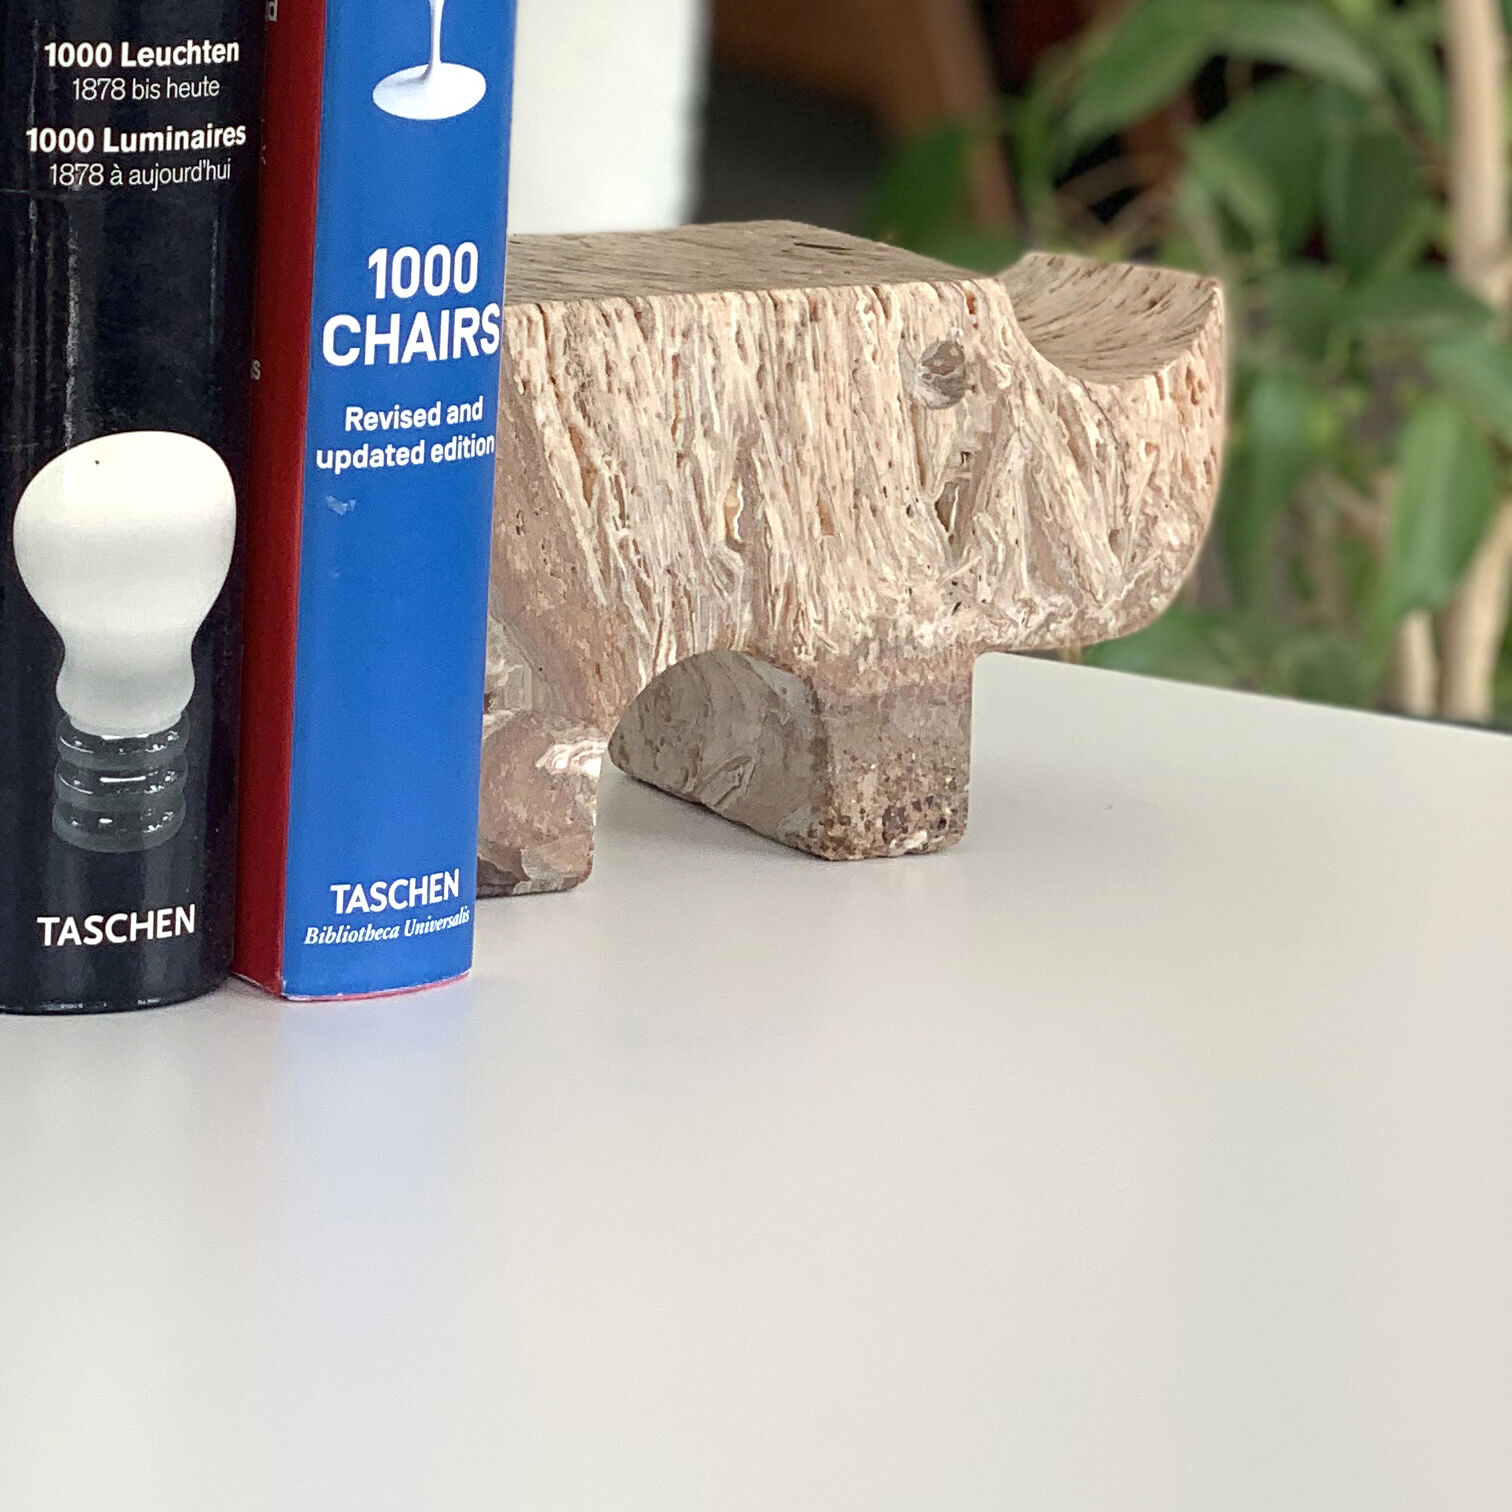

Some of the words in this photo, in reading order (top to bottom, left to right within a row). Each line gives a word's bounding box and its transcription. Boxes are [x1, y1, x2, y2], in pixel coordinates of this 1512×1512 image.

[45, 43, 112, 67] 1000
[121, 40, 239, 67] Leuchten
[73, 78, 125, 100] 1878
[132, 78, 160, 100] bis
[167, 76, 219, 98] heute
[26, 128, 94, 153] 1000
[103, 123, 246, 152] Luminaires
[50, 163, 104, 189] 1878
[110, 164, 123, 185] à
[129, 159, 230, 191] aujourd'hui
[368, 242, 478, 299] 1000
[323, 298, 500, 366] CHAIRS
[345, 401, 441, 432] Revised
[447, 396, 483, 424] and
[317, 439, 425, 474] updated
[431, 433, 494, 463] edition
[331, 869, 459, 915] TASCHEN
[37, 904, 195, 946] TASCHEN
[303, 913, 401, 948] Bibliotheca
[402, 901, 470, 937] Universalis
